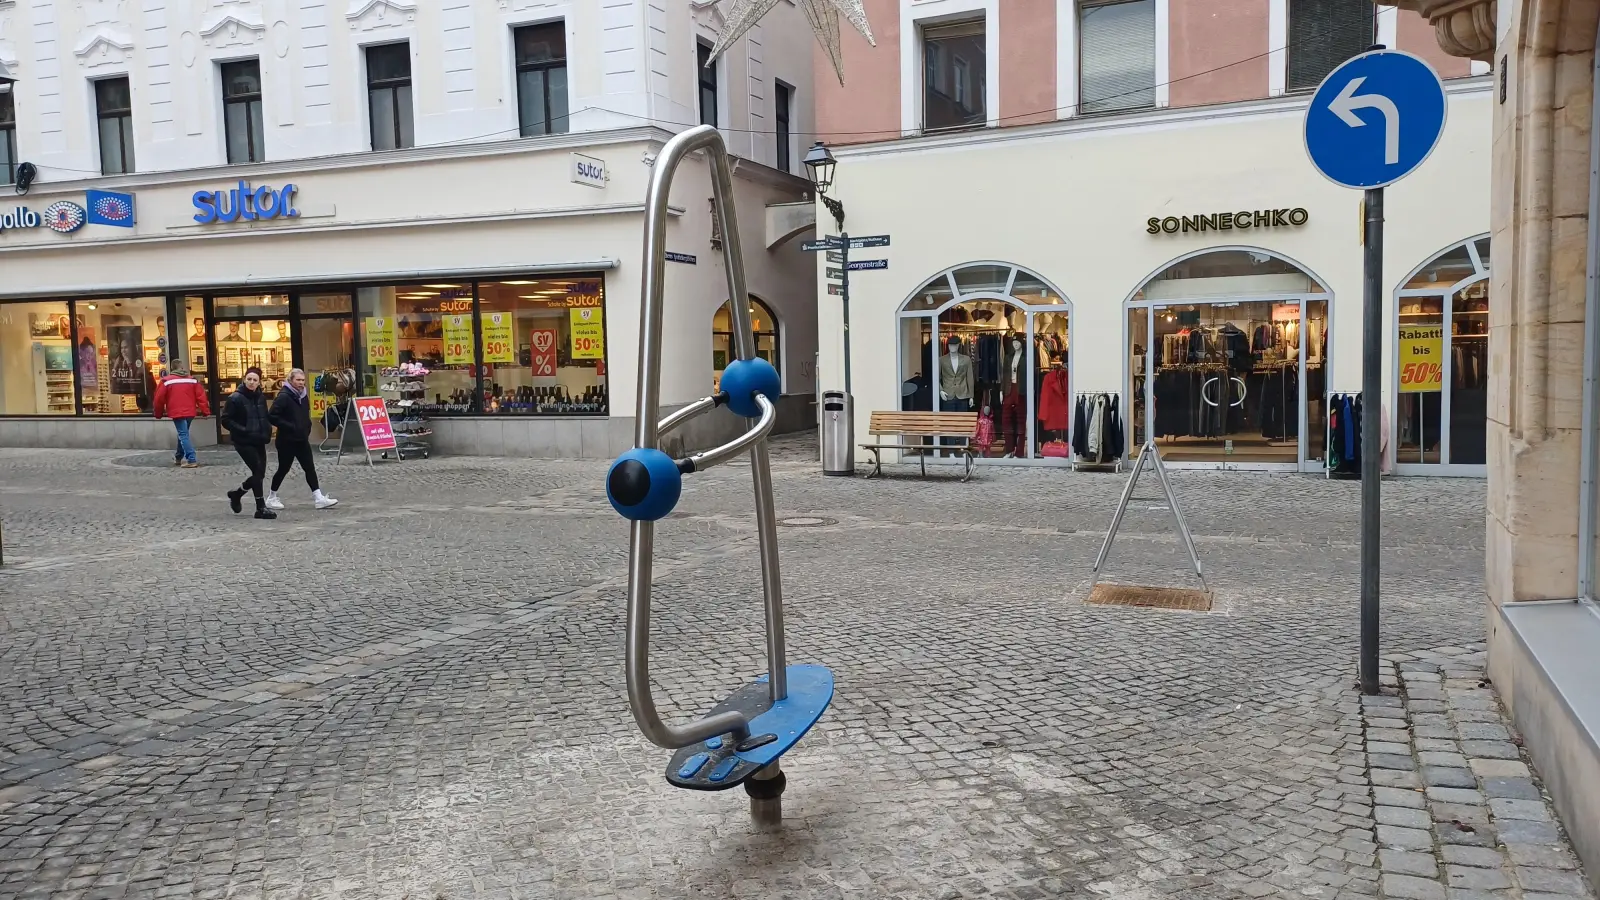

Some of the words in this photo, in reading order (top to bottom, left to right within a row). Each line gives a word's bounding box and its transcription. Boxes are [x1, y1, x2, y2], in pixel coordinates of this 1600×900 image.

[0, 206, 40, 229] ollo
[1146, 207, 1309, 235] SONNECHKO
[537, 334, 549, 345] SV
[575, 338, 600, 351] 50%
[370, 345, 393, 357] 50%
[447, 343, 470, 356] 50%
[487, 341, 511, 355] 50%
[1412, 346, 1431, 355] bis
[111, 369, 117, 378] 2
[118, 368, 129, 378] für
[1400, 362, 1443, 384] 50%
[360, 405, 386, 421] 20%
